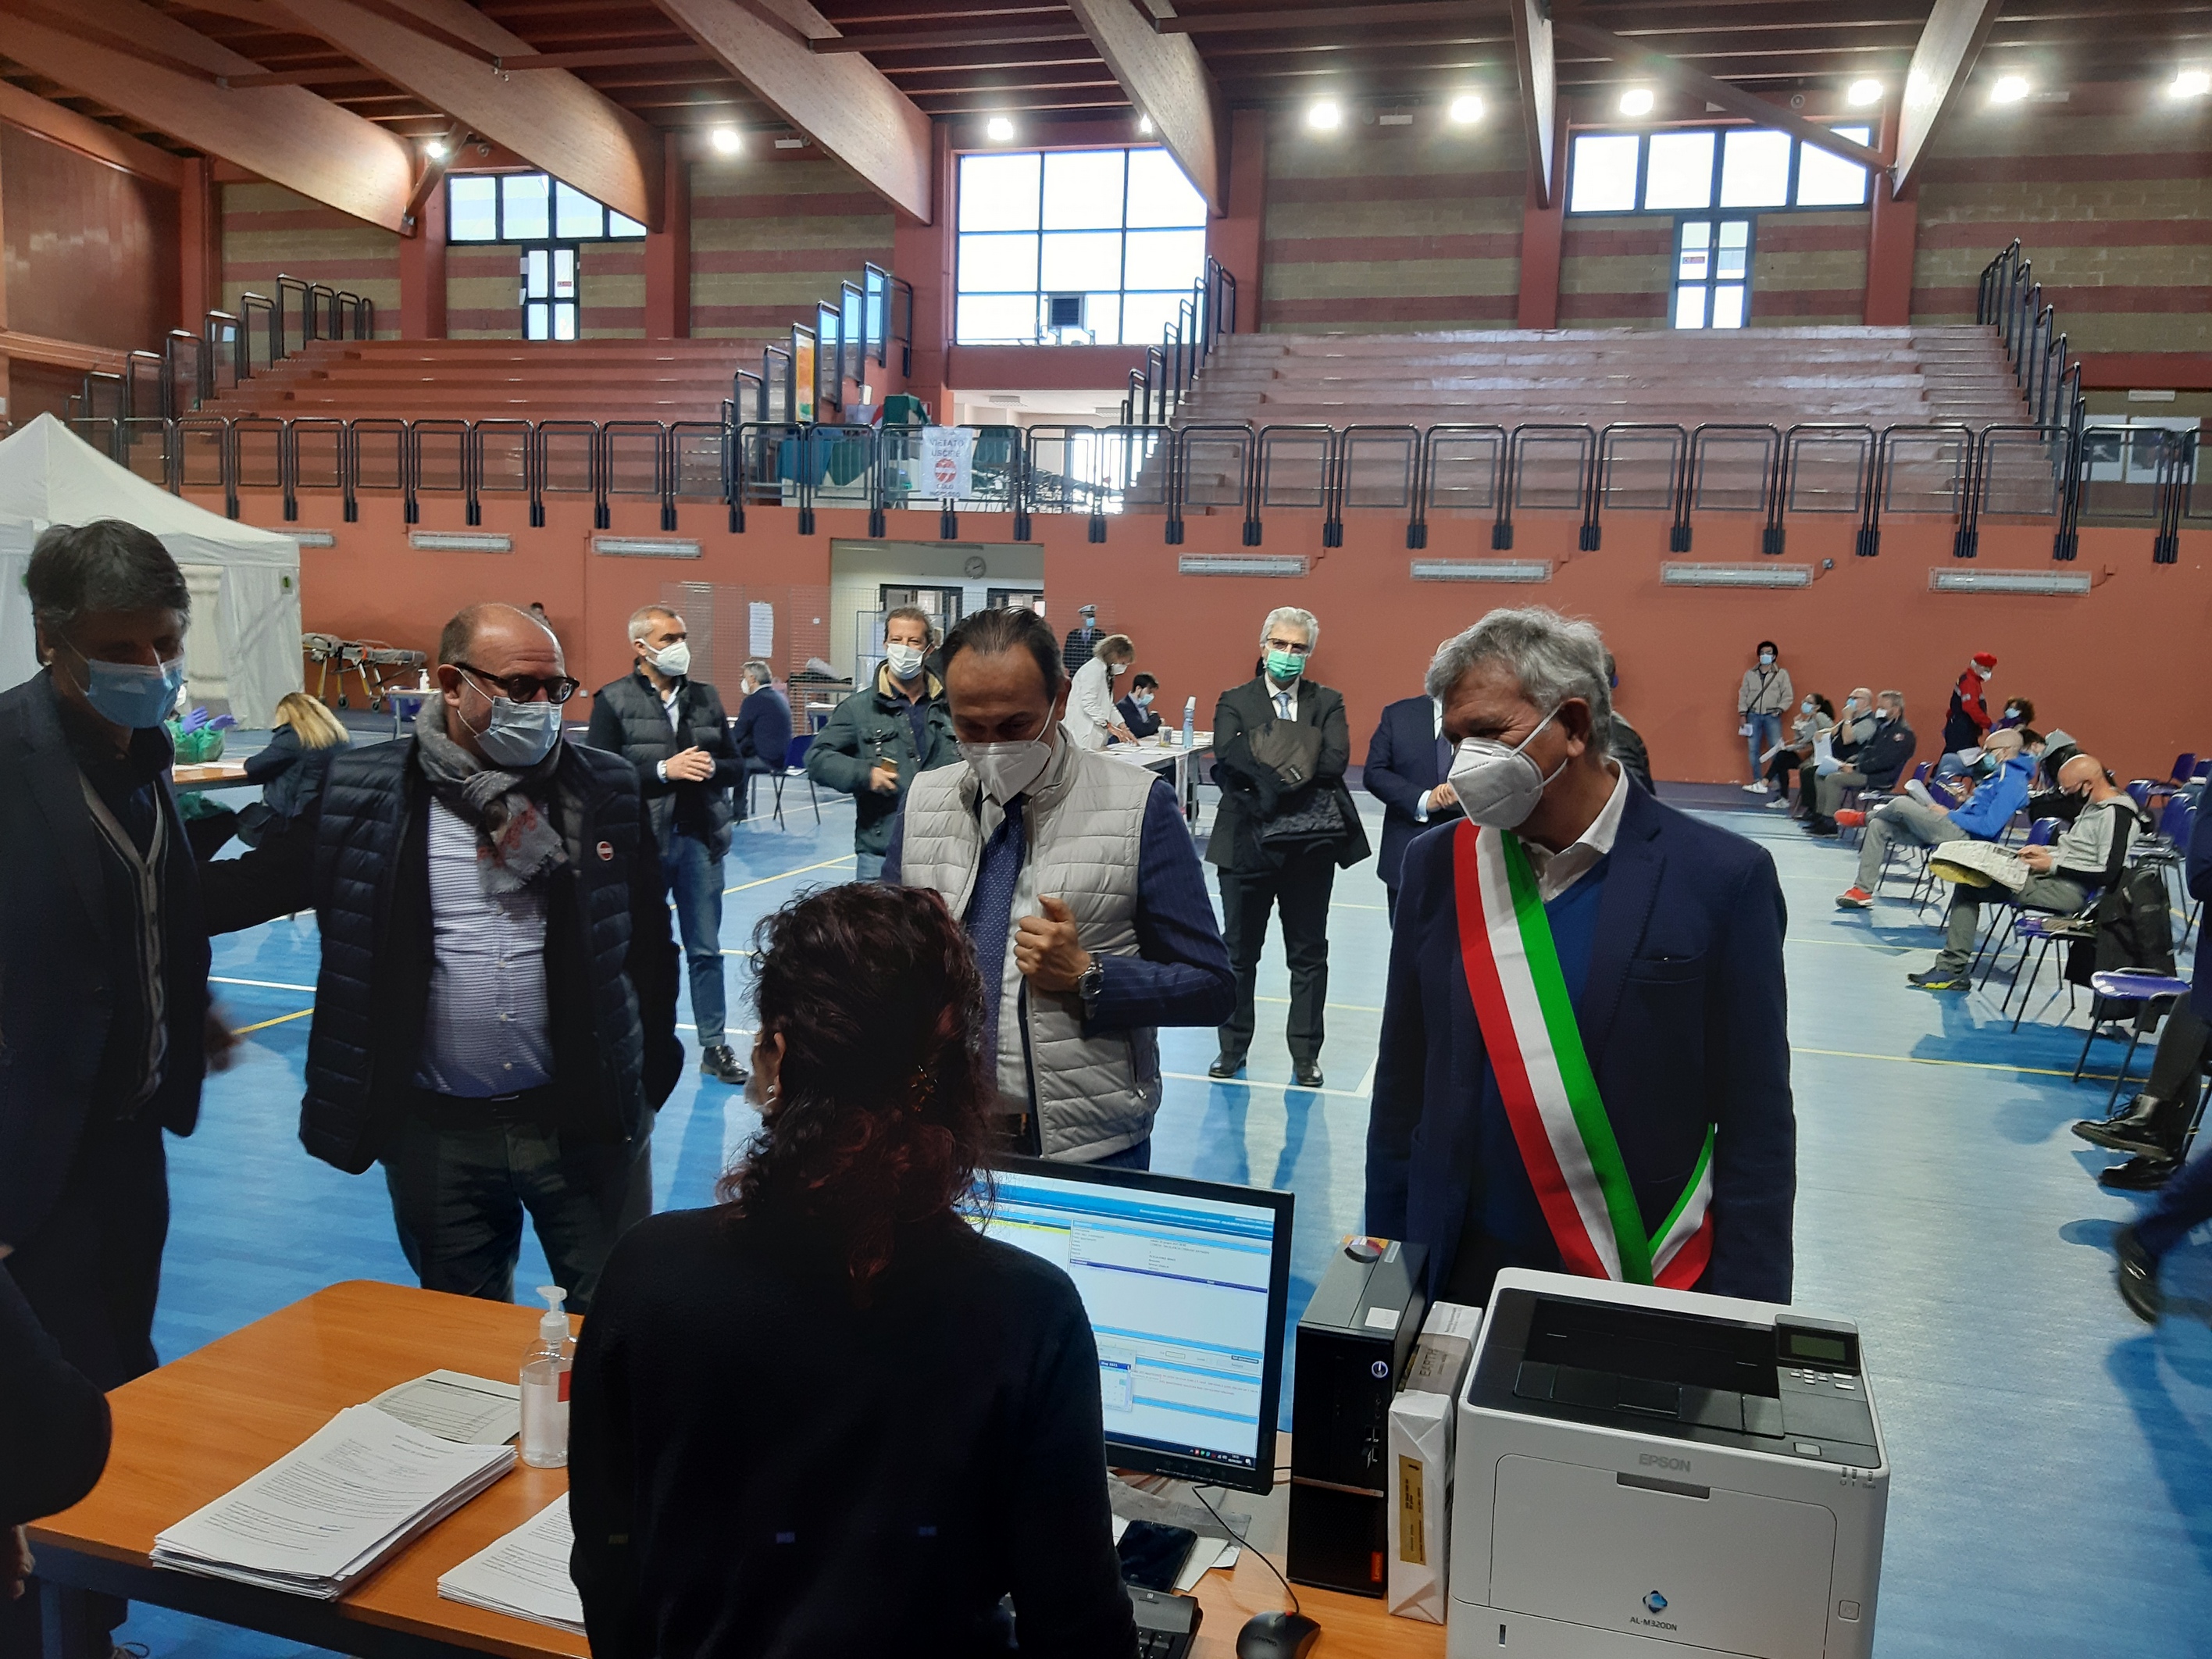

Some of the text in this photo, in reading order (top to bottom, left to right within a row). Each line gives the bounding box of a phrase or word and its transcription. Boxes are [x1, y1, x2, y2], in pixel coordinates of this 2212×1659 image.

[1418, 1347, 1440, 1377] EARTH
[1639, 1452, 1691, 1473] EPSON
[1629, 1616, 1678, 1631] AL-M320DN
